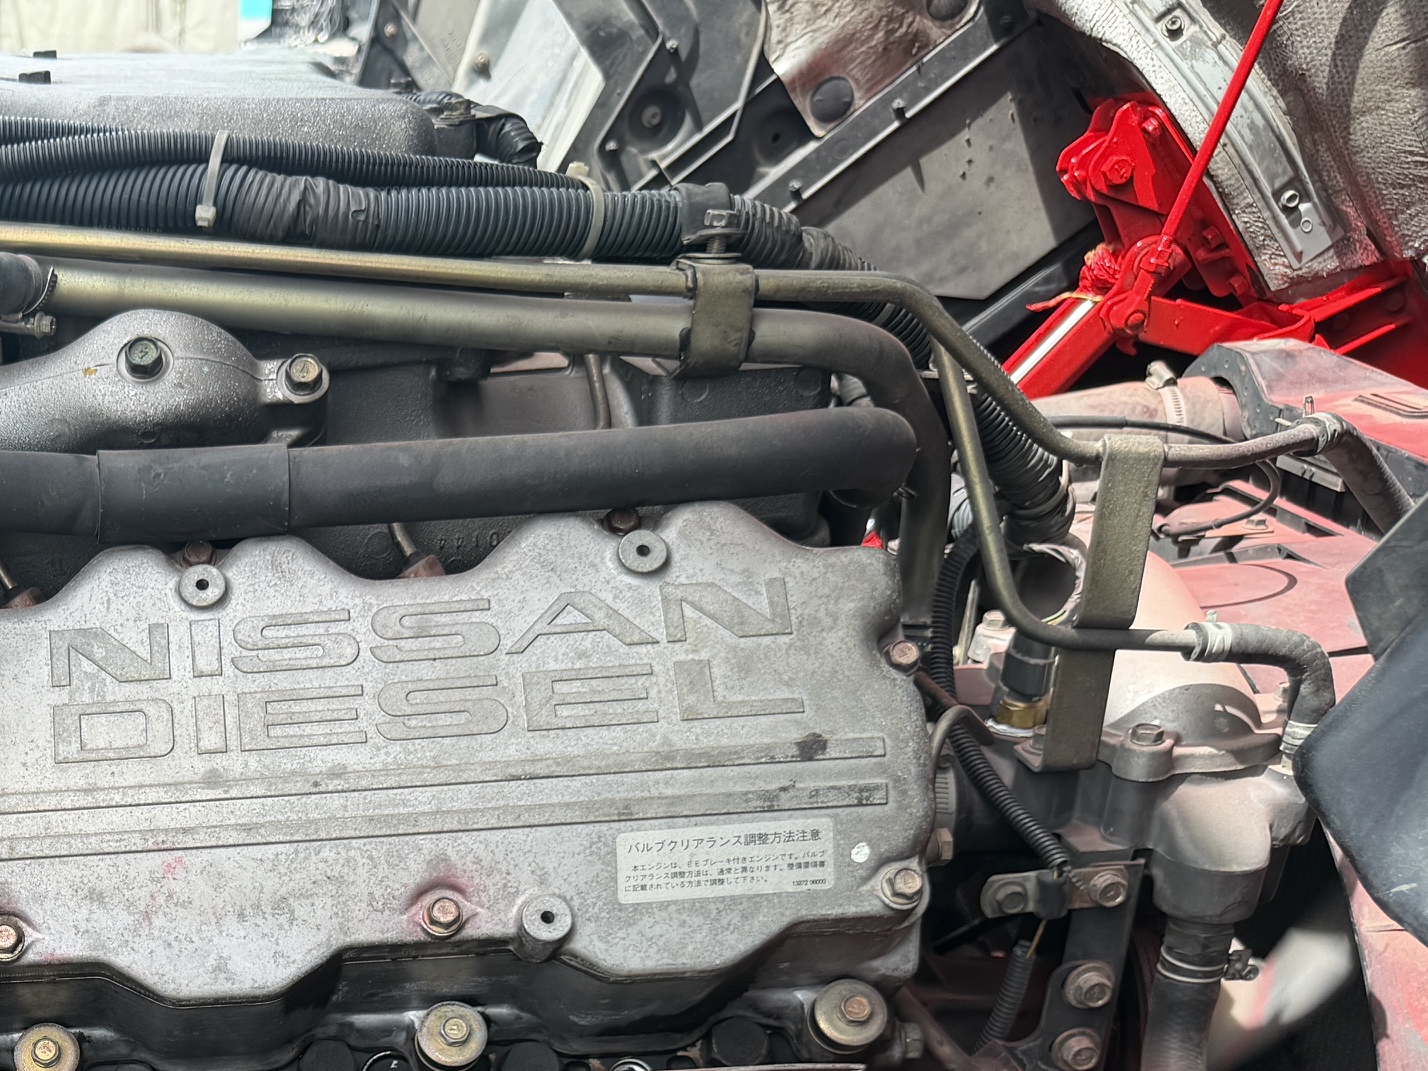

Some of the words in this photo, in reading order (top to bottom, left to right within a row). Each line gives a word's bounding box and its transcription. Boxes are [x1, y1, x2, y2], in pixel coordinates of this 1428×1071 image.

[49, 577, 794, 687] NISSAN
[53, 658, 806, 764] DIESEL
[627, 828, 822, 854] バルブクリアランス調整方法注意
